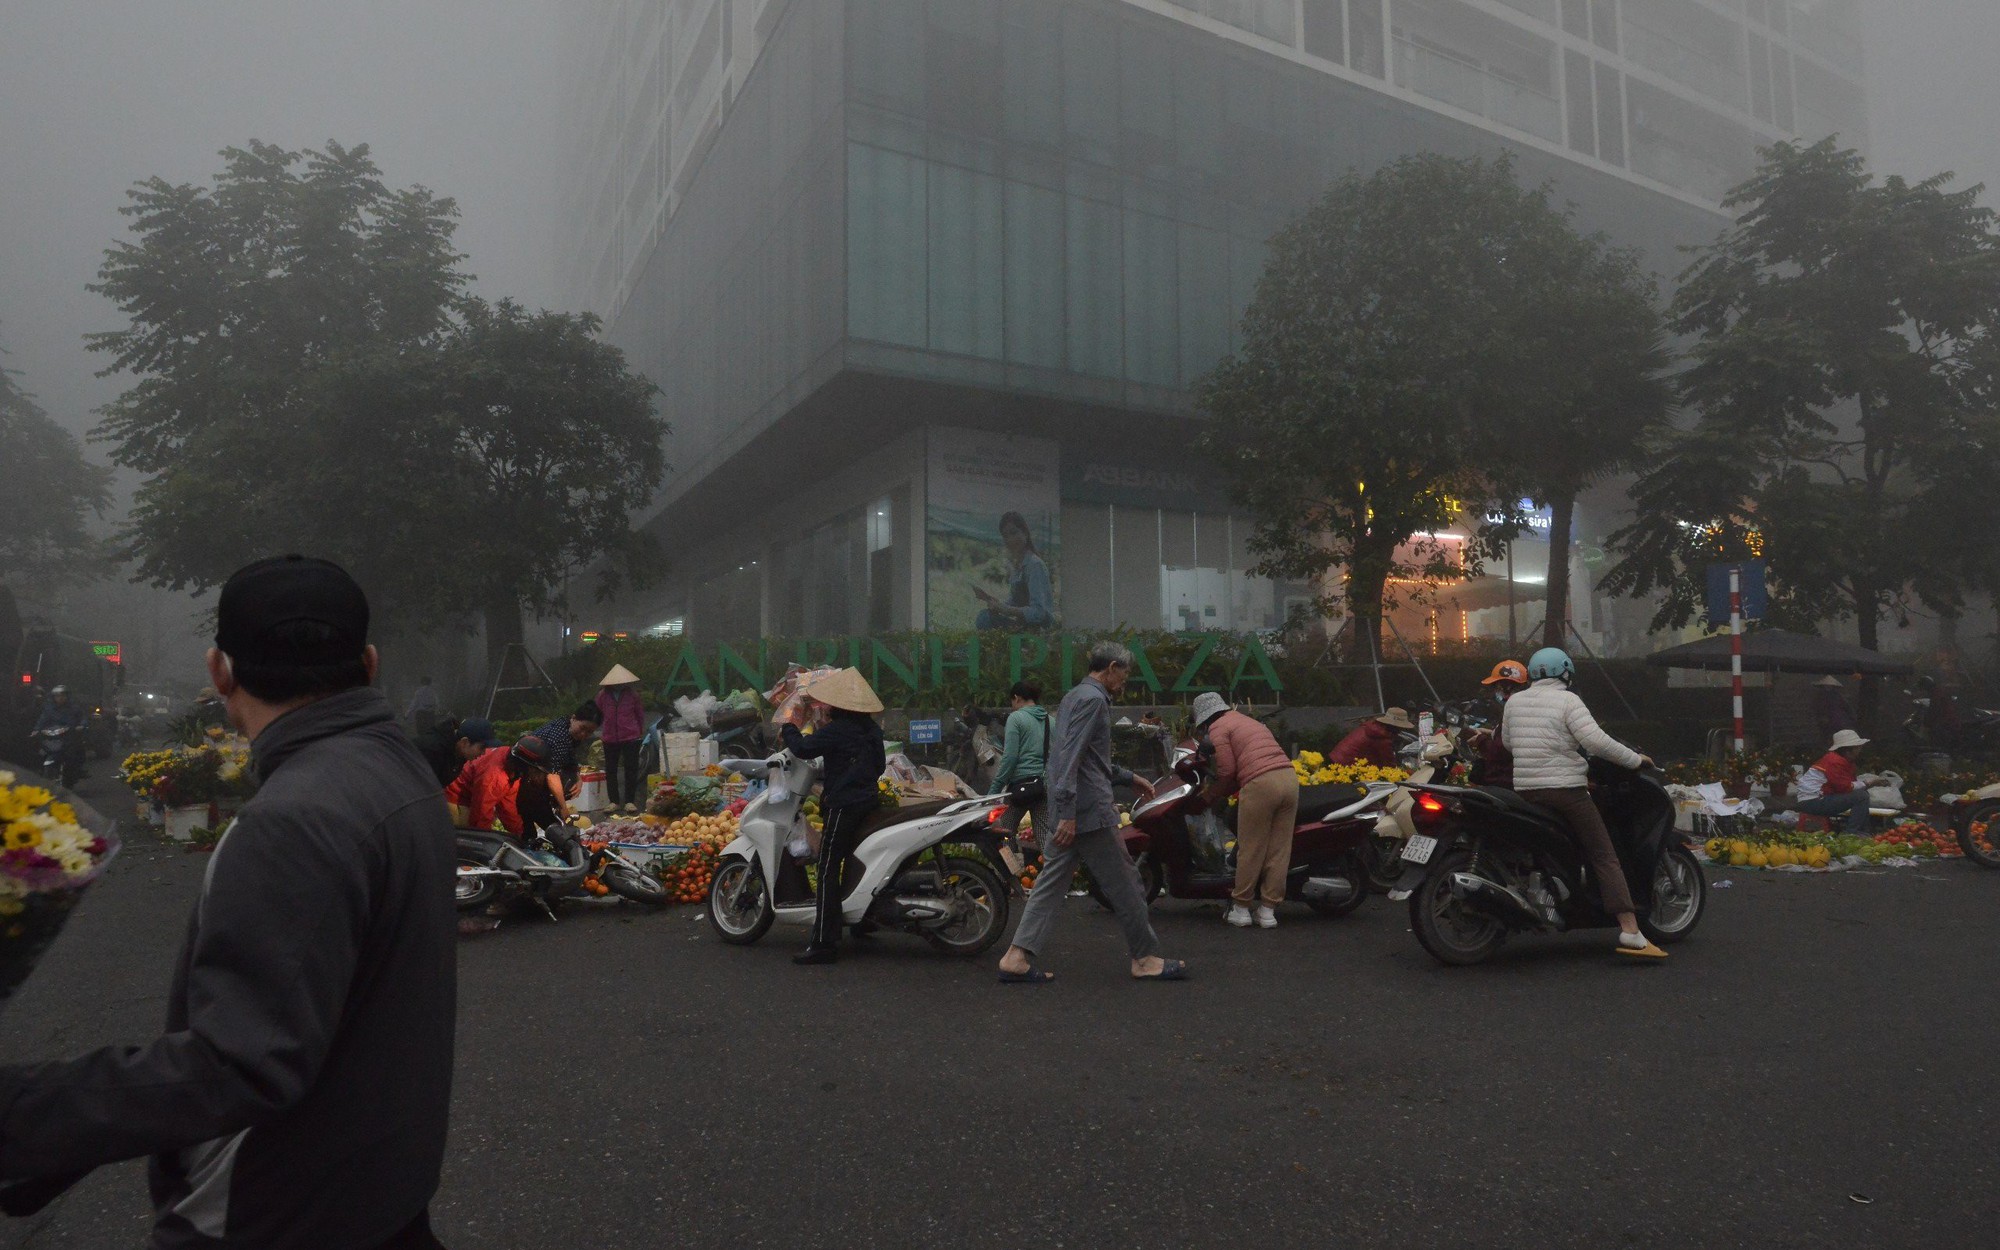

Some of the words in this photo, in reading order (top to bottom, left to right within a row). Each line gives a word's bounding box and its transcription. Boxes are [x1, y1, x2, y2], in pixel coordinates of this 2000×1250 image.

[1083, 463, 1200, 492] ABBANK
[1528, 514, 1547, 528] sữa
[662, 637, 768, 698] AN
